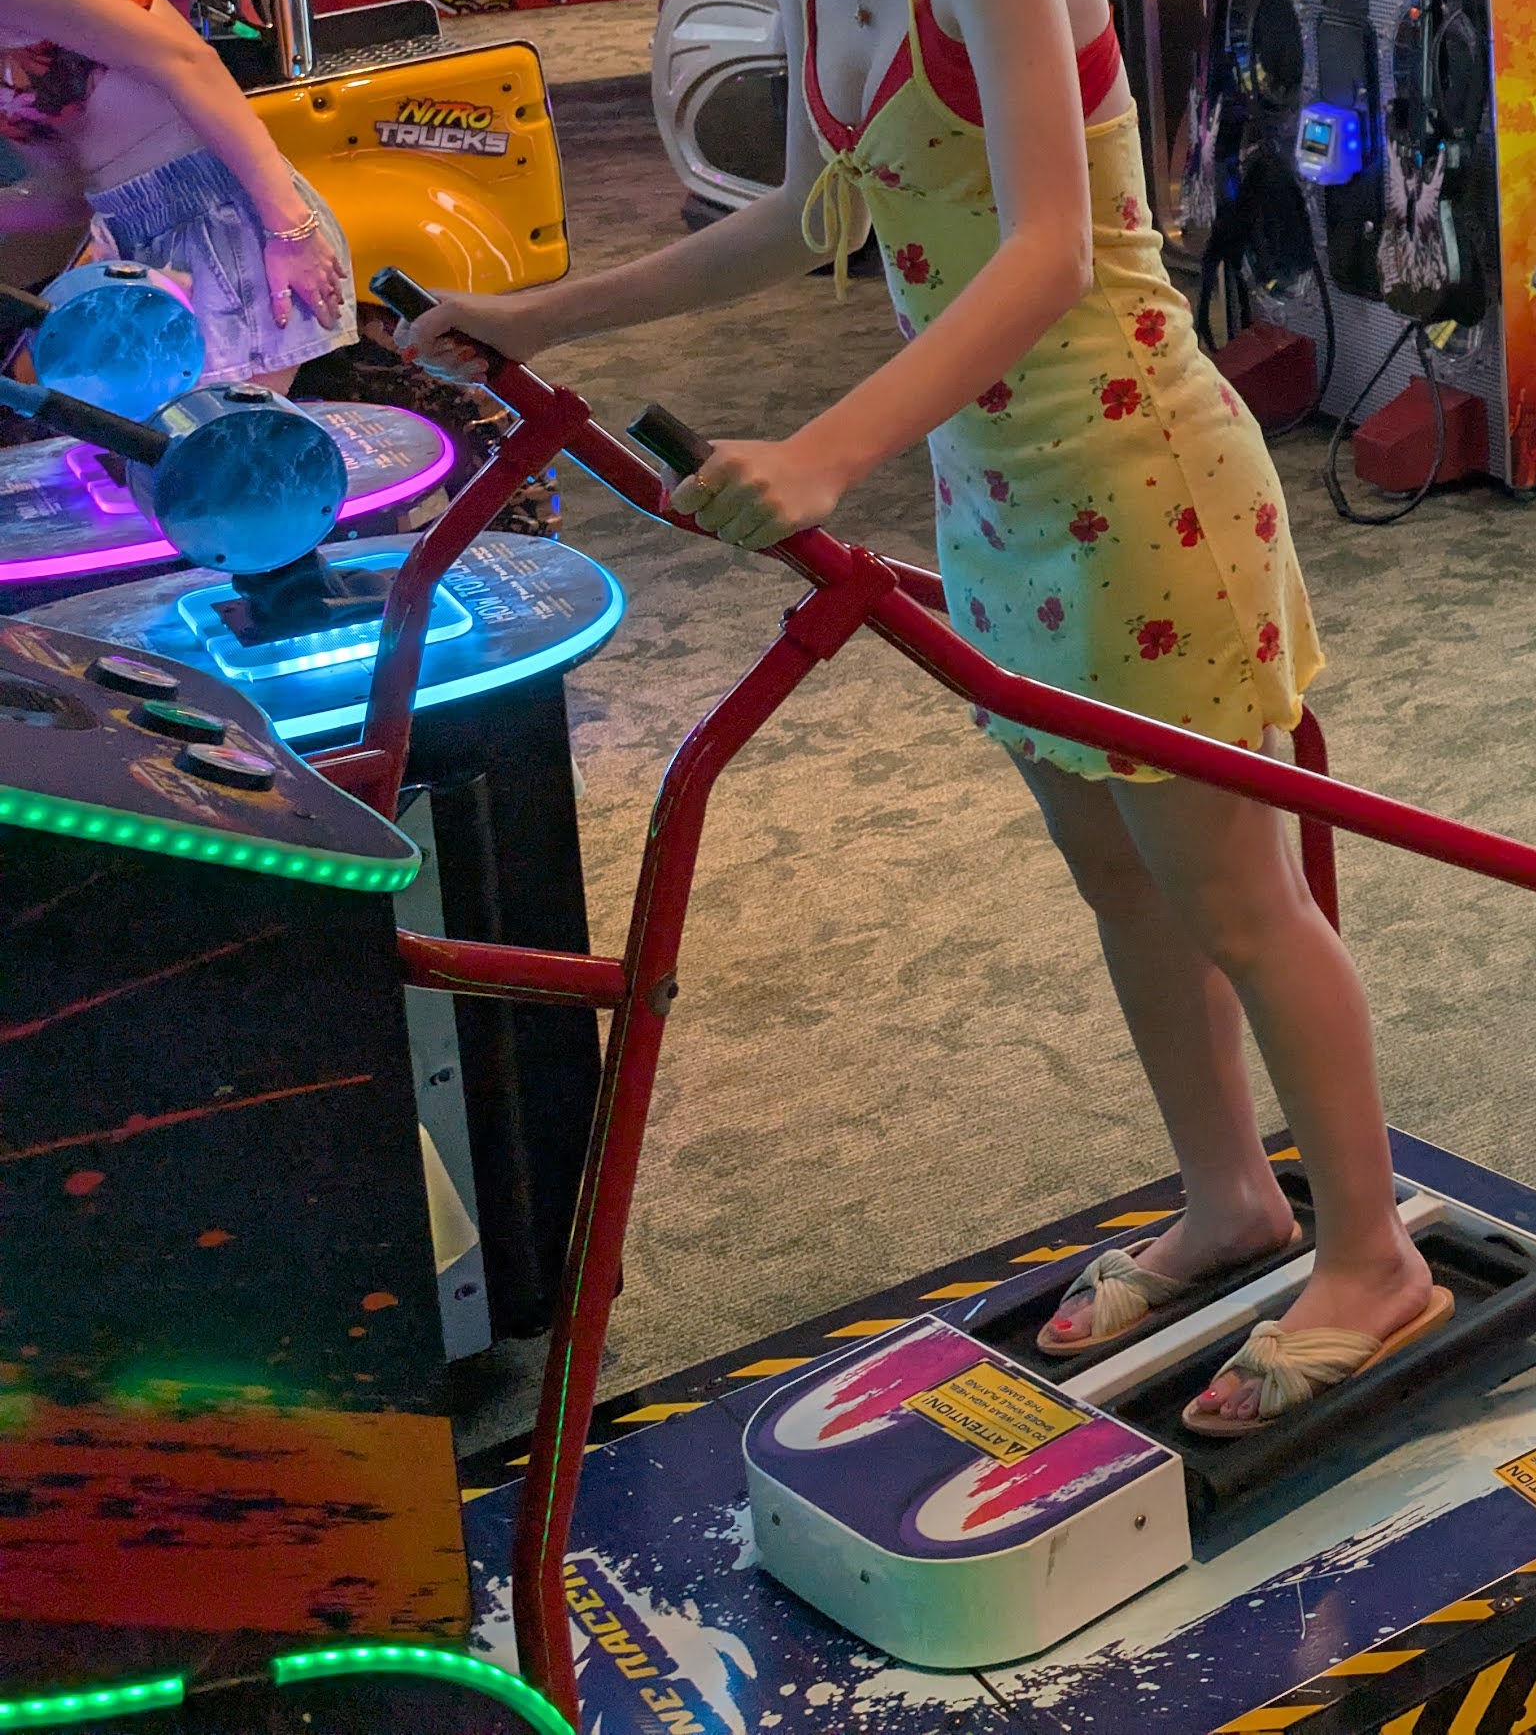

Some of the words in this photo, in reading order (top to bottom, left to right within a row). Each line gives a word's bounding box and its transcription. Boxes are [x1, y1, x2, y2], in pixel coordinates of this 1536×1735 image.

[400, 100, 492, 129] NITRO
[376, 122, 509, 153] TRUCKS
[922, 1395, 1008, 1445] ATTENTION!
